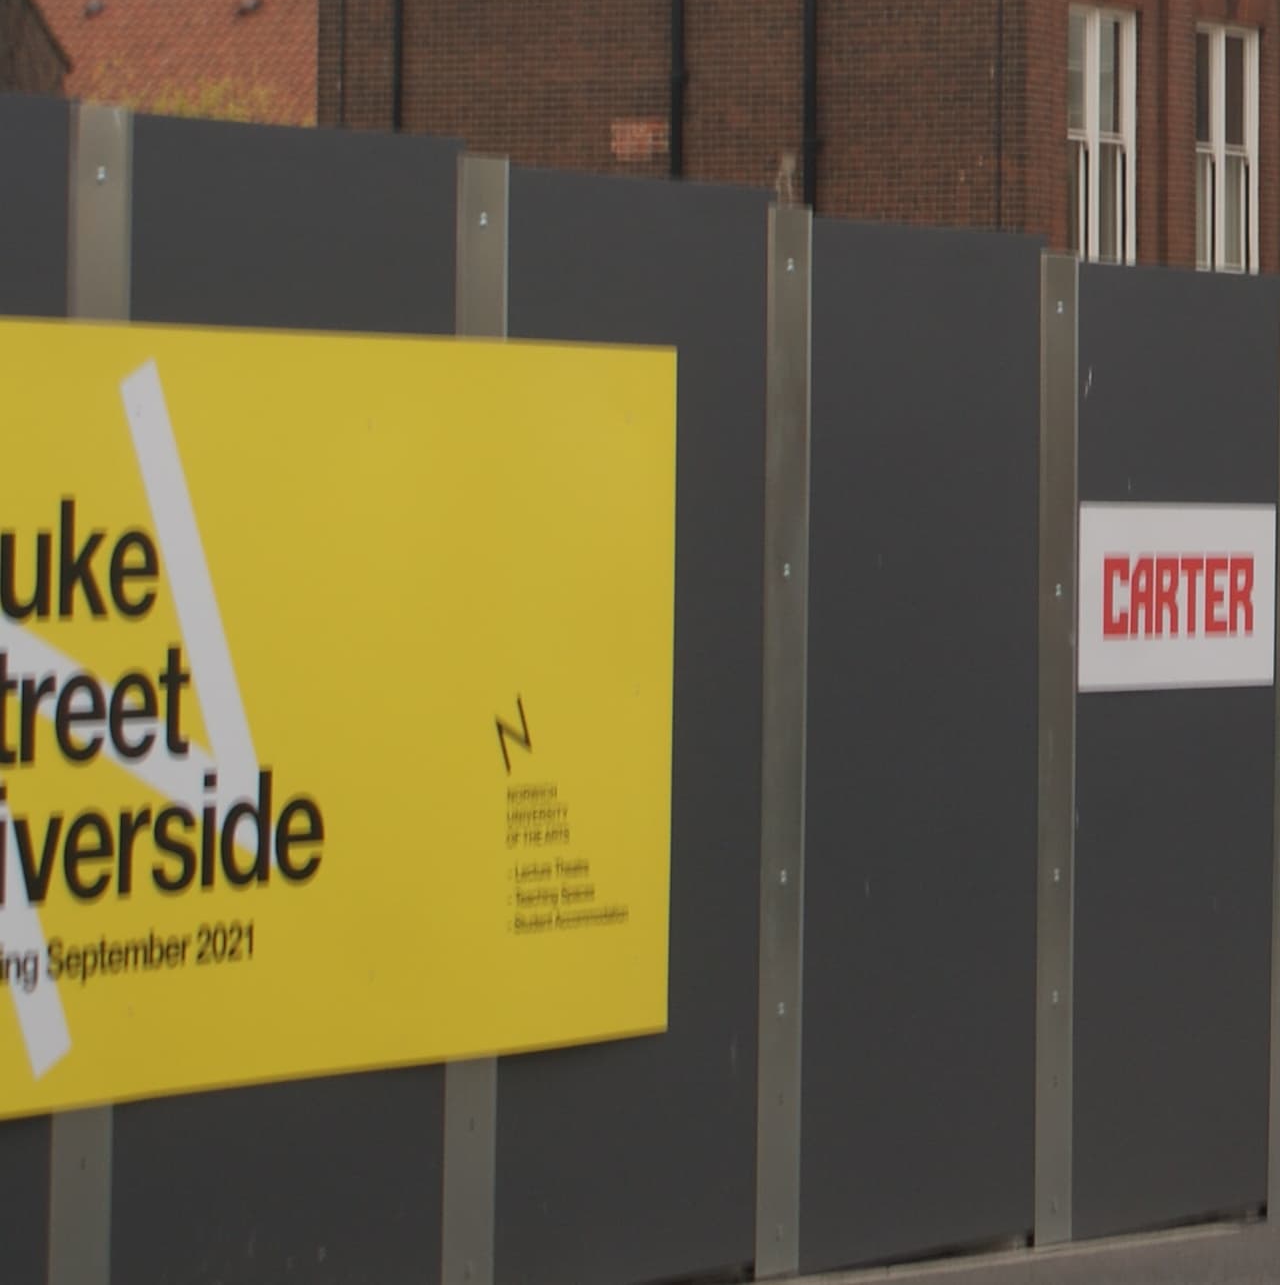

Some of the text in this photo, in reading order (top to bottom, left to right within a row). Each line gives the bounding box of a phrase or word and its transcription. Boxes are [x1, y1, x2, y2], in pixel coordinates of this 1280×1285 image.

[0, 494, 159, 620] uke
[1103, 552, 1254, 640] CARTER
[0, 643, 189, 766] treet
[0, 766, 325, 907] iverside
[47, 926, 192, 985] September
[196, 919, 255, 965] 2021
